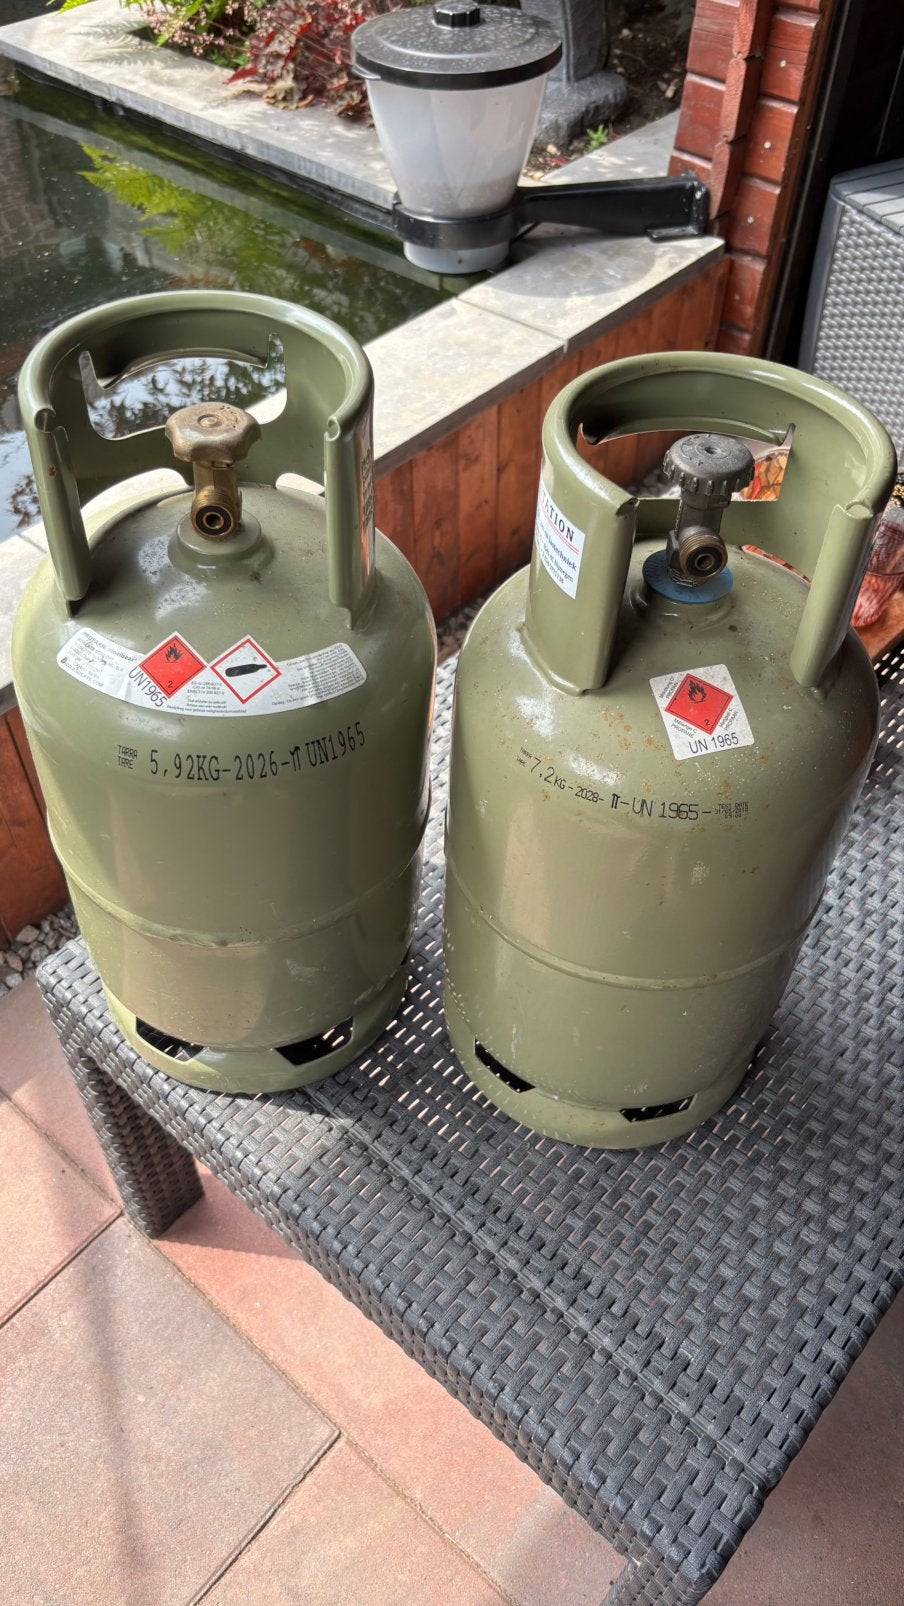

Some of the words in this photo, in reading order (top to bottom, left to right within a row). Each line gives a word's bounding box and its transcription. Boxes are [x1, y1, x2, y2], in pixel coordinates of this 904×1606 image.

[128, 666, 168, 708] UN1965
[168, 680, 174, 689] 2
[704, 719, 711, 727] 2
[304, 720, 366, 767] UN1965
[688, 738, 709, 754] UN
[711, 731, 740, 750] 1965
[118, 744, 138, 760] TARRA
[117, 755, 135, 770] TARE
